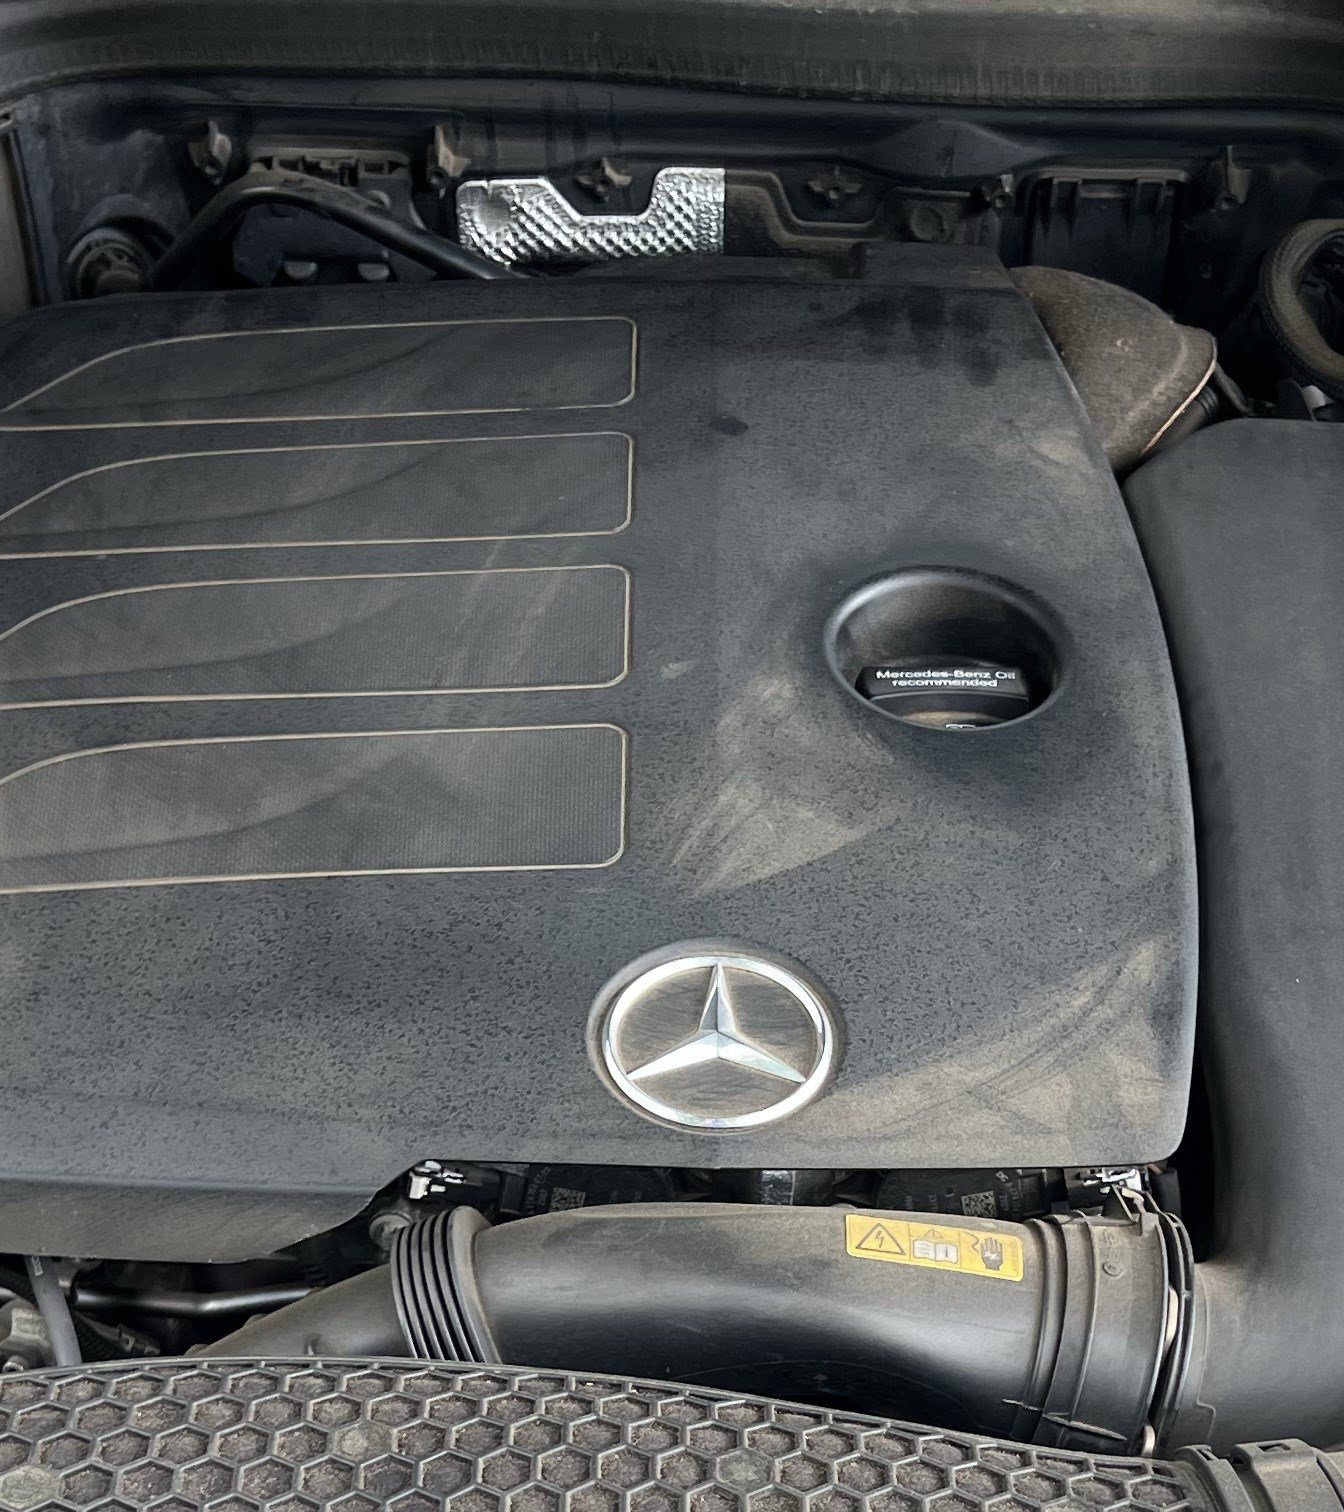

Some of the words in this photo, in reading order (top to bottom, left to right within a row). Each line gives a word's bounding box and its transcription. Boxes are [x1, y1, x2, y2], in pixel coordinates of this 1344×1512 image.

[876, 669, 991, 679] Mercedes-Benz
[995, 670, 1016, 680] Oil
[891, 679, 998, 688] recommended
